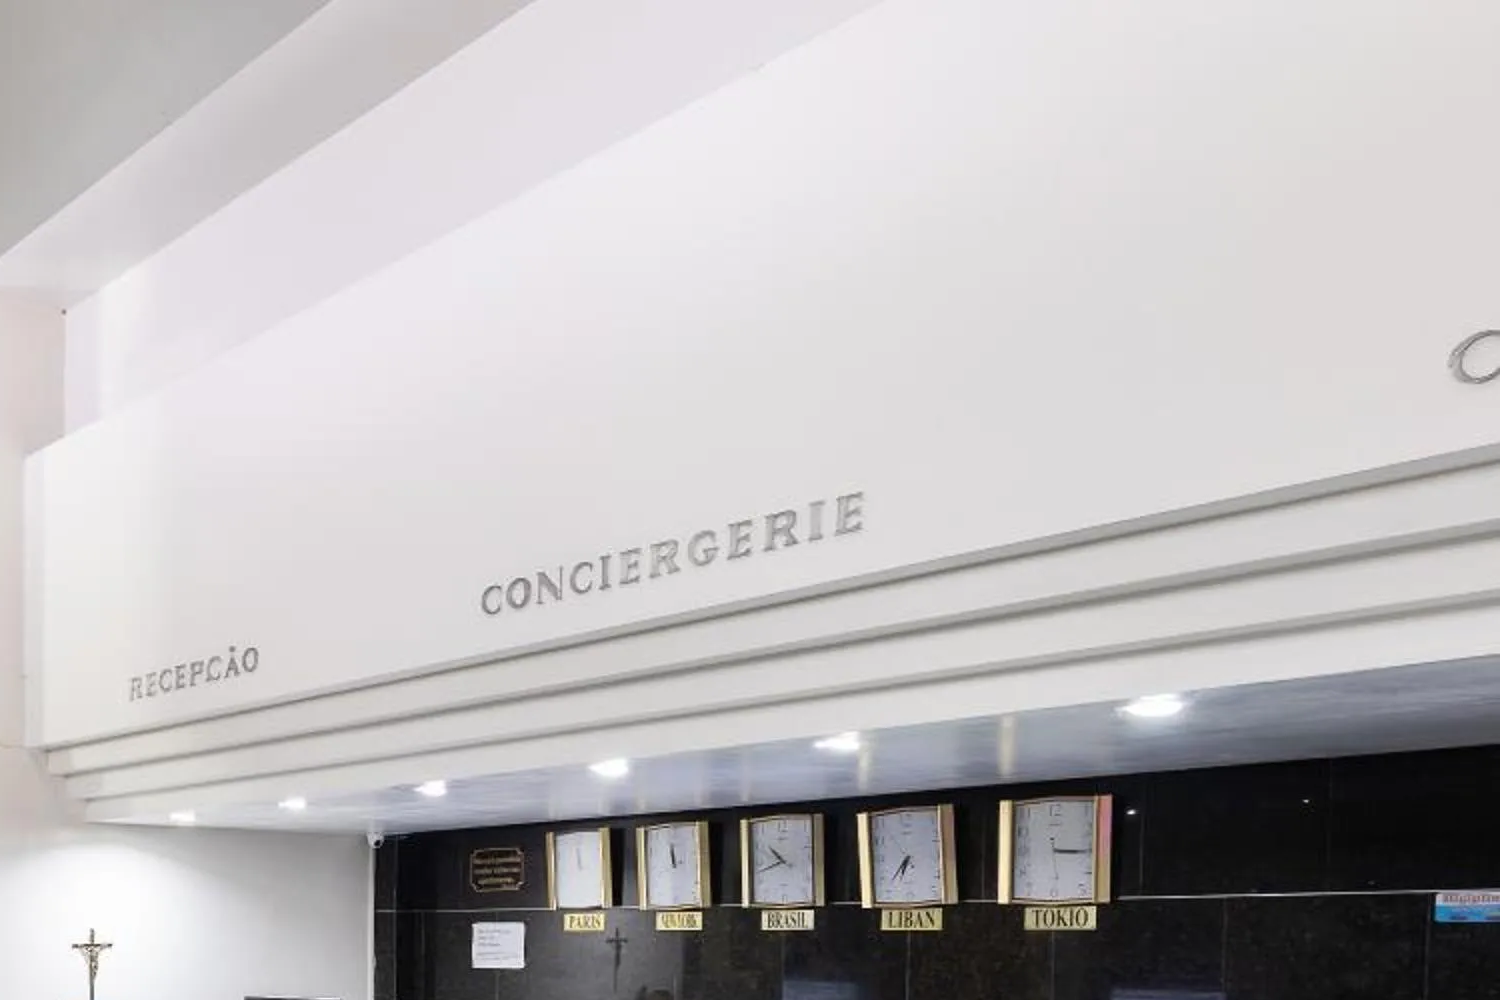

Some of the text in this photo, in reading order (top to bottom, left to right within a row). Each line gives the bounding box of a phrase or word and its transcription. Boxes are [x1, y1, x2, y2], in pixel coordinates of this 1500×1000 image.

[479, 491, 864, 616] CONCIERGERIE
[767, 911, 808, 929] BRASIL
[888, 911, 936, 928] LIBAN
[1031, 907, 1089, 928] TOKIO
